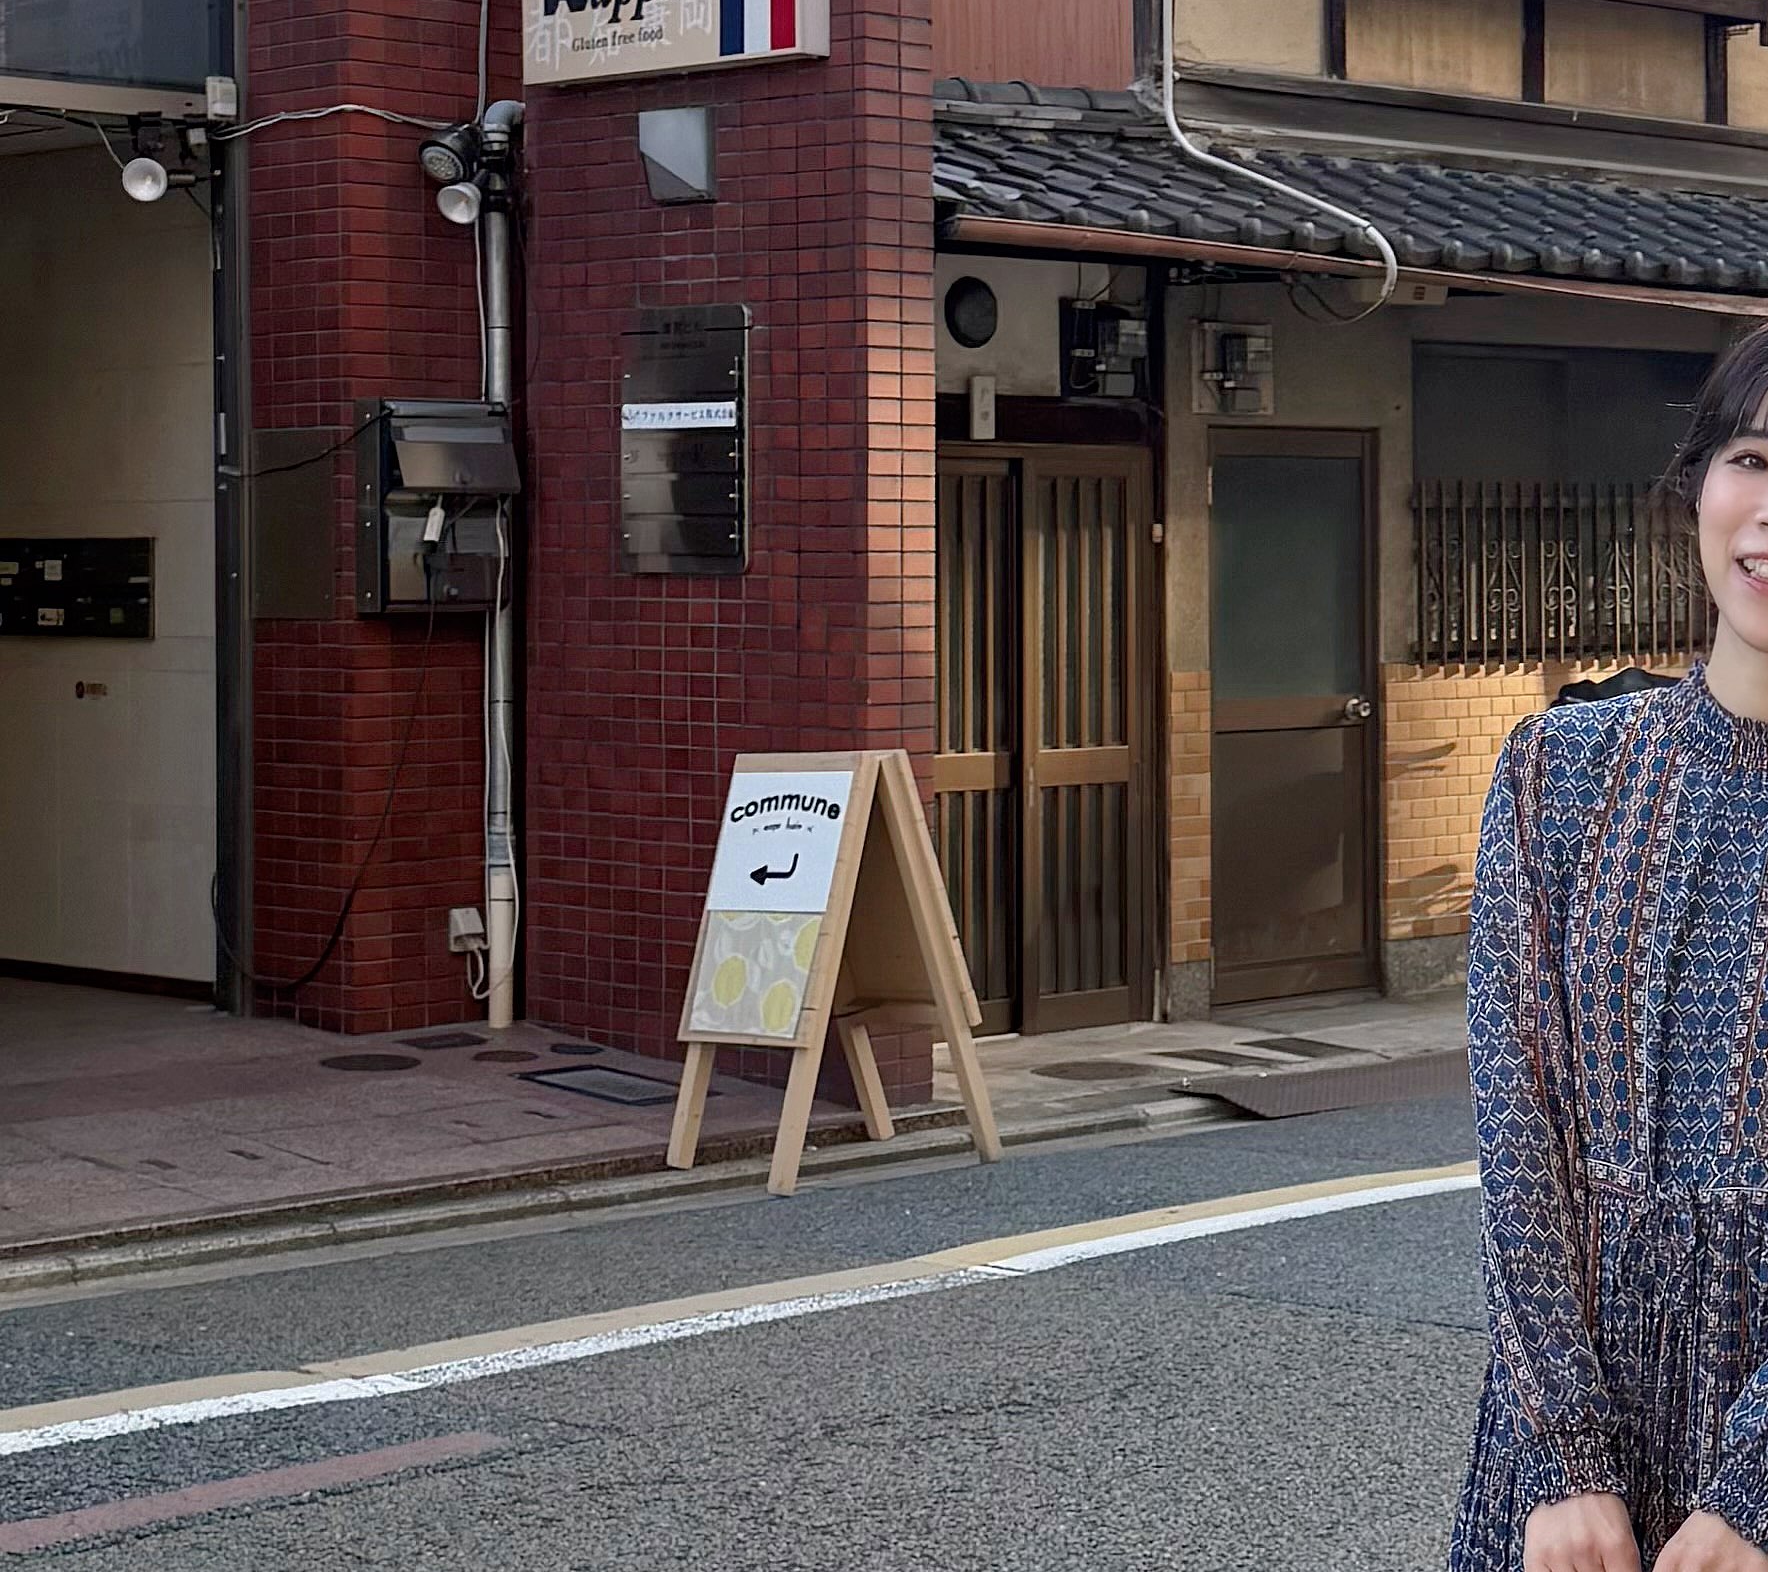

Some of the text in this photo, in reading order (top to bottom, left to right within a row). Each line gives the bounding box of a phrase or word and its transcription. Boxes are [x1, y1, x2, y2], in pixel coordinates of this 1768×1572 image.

[572, 25, 664, 52] Gluten free food
[730, 793, 841, 823] commune
